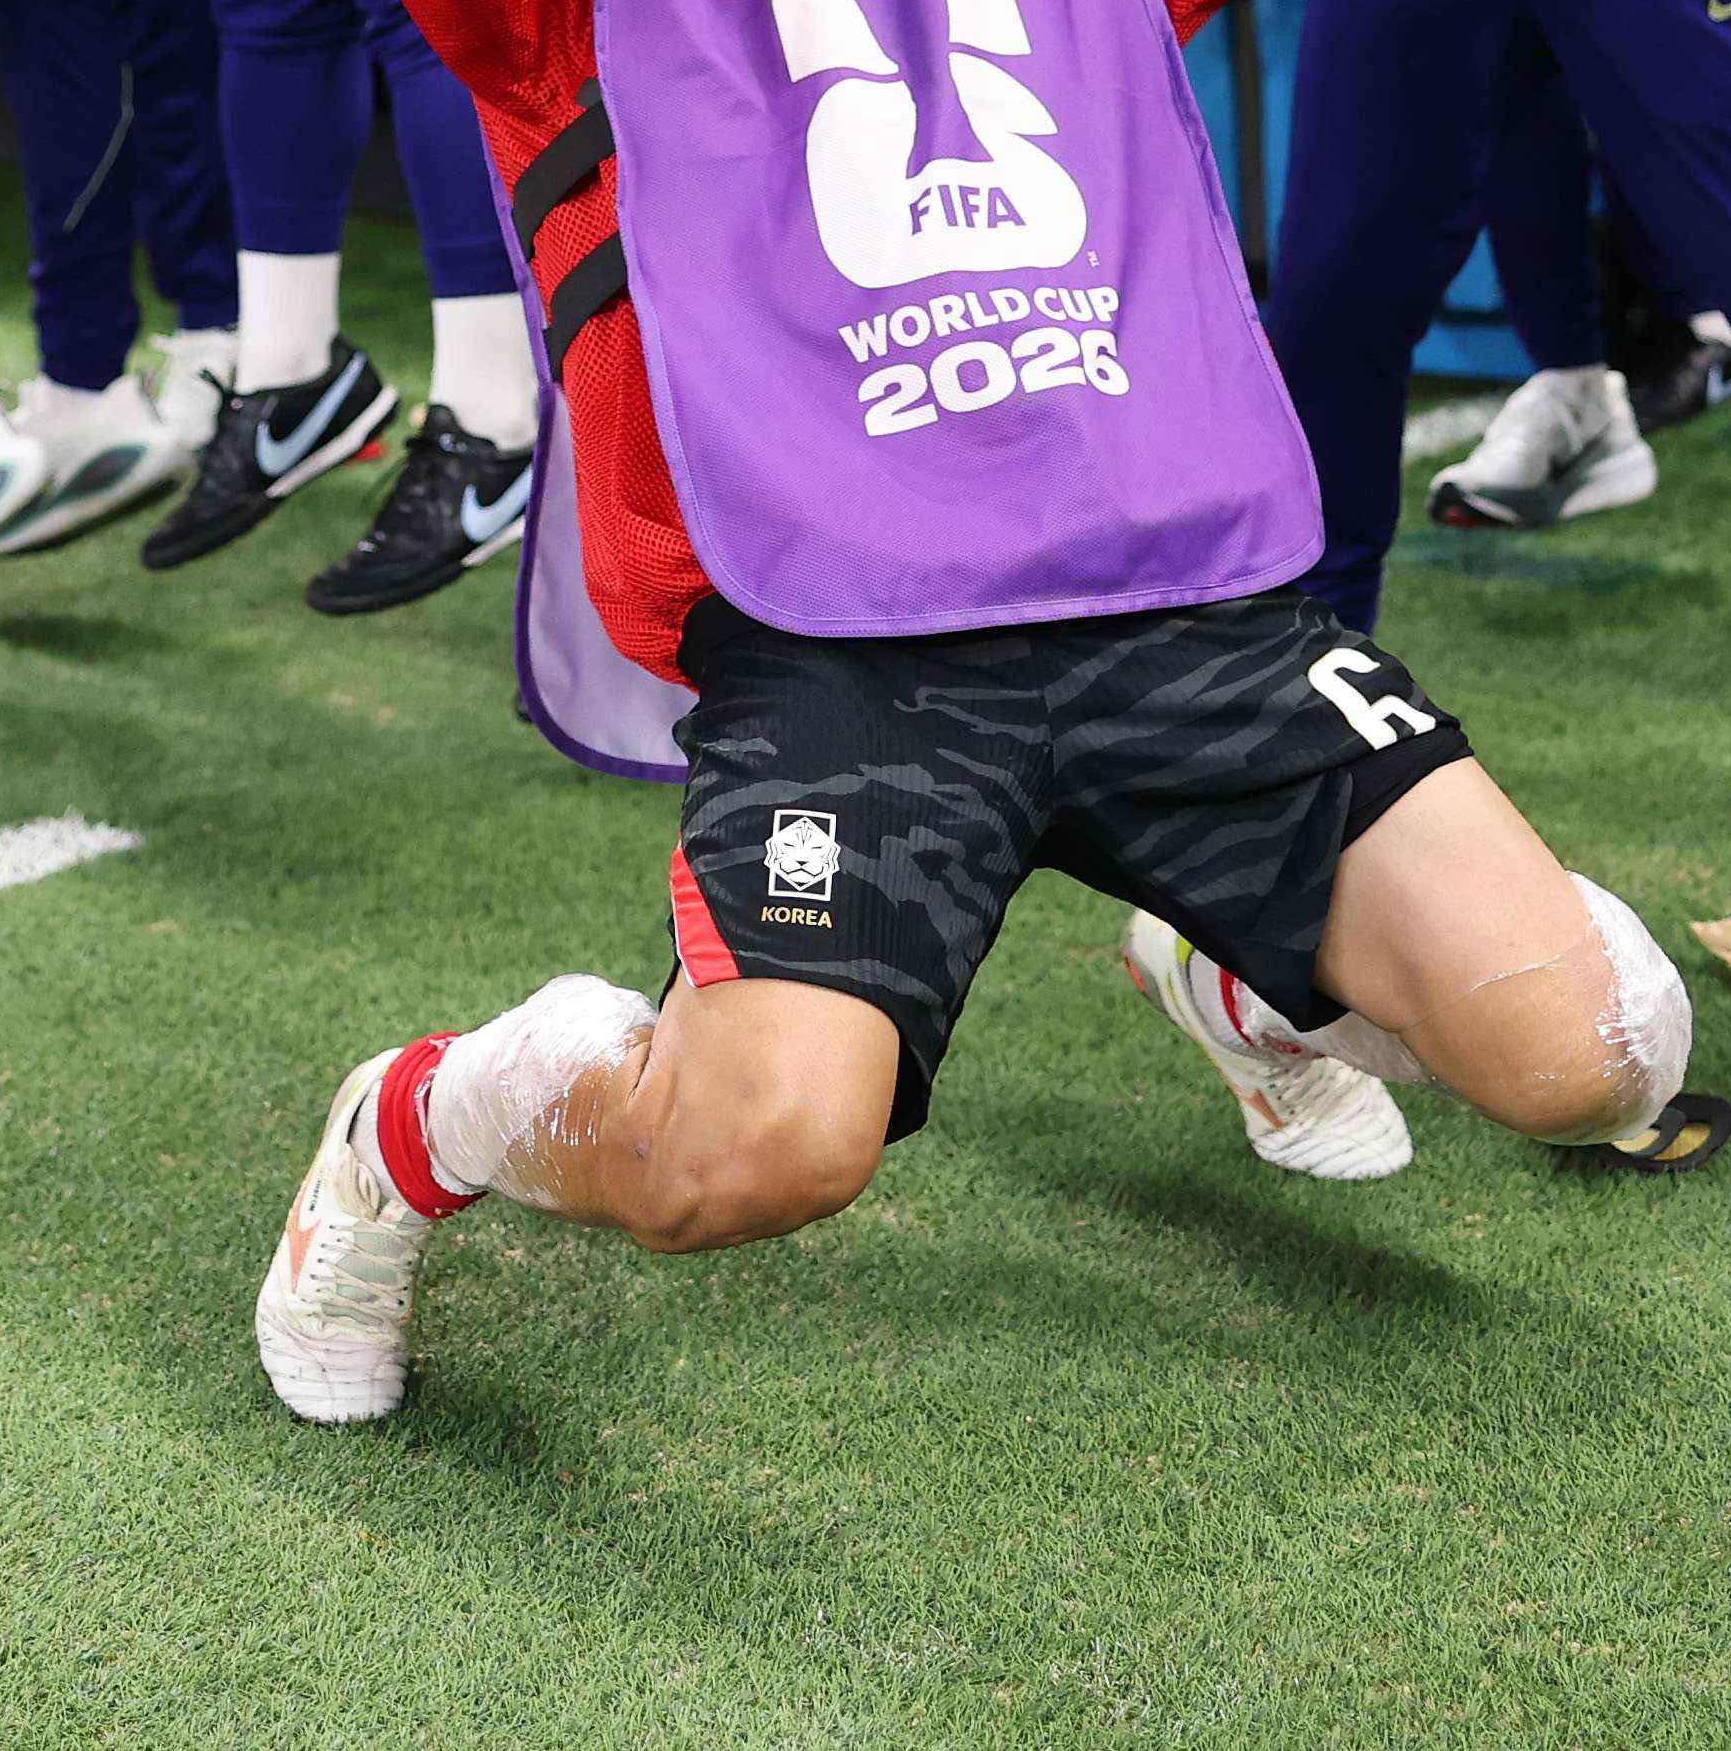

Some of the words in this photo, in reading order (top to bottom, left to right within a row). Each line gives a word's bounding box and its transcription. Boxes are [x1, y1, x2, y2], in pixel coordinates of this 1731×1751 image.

[908, 183, 1027, 237] FIFA
[837, 287, 1032, 363] WORLD
[1033, 285, 1119, 323] CUP
[857, 326, 1131, 438] 2026
[760, 906, 833, 929] KOREA
